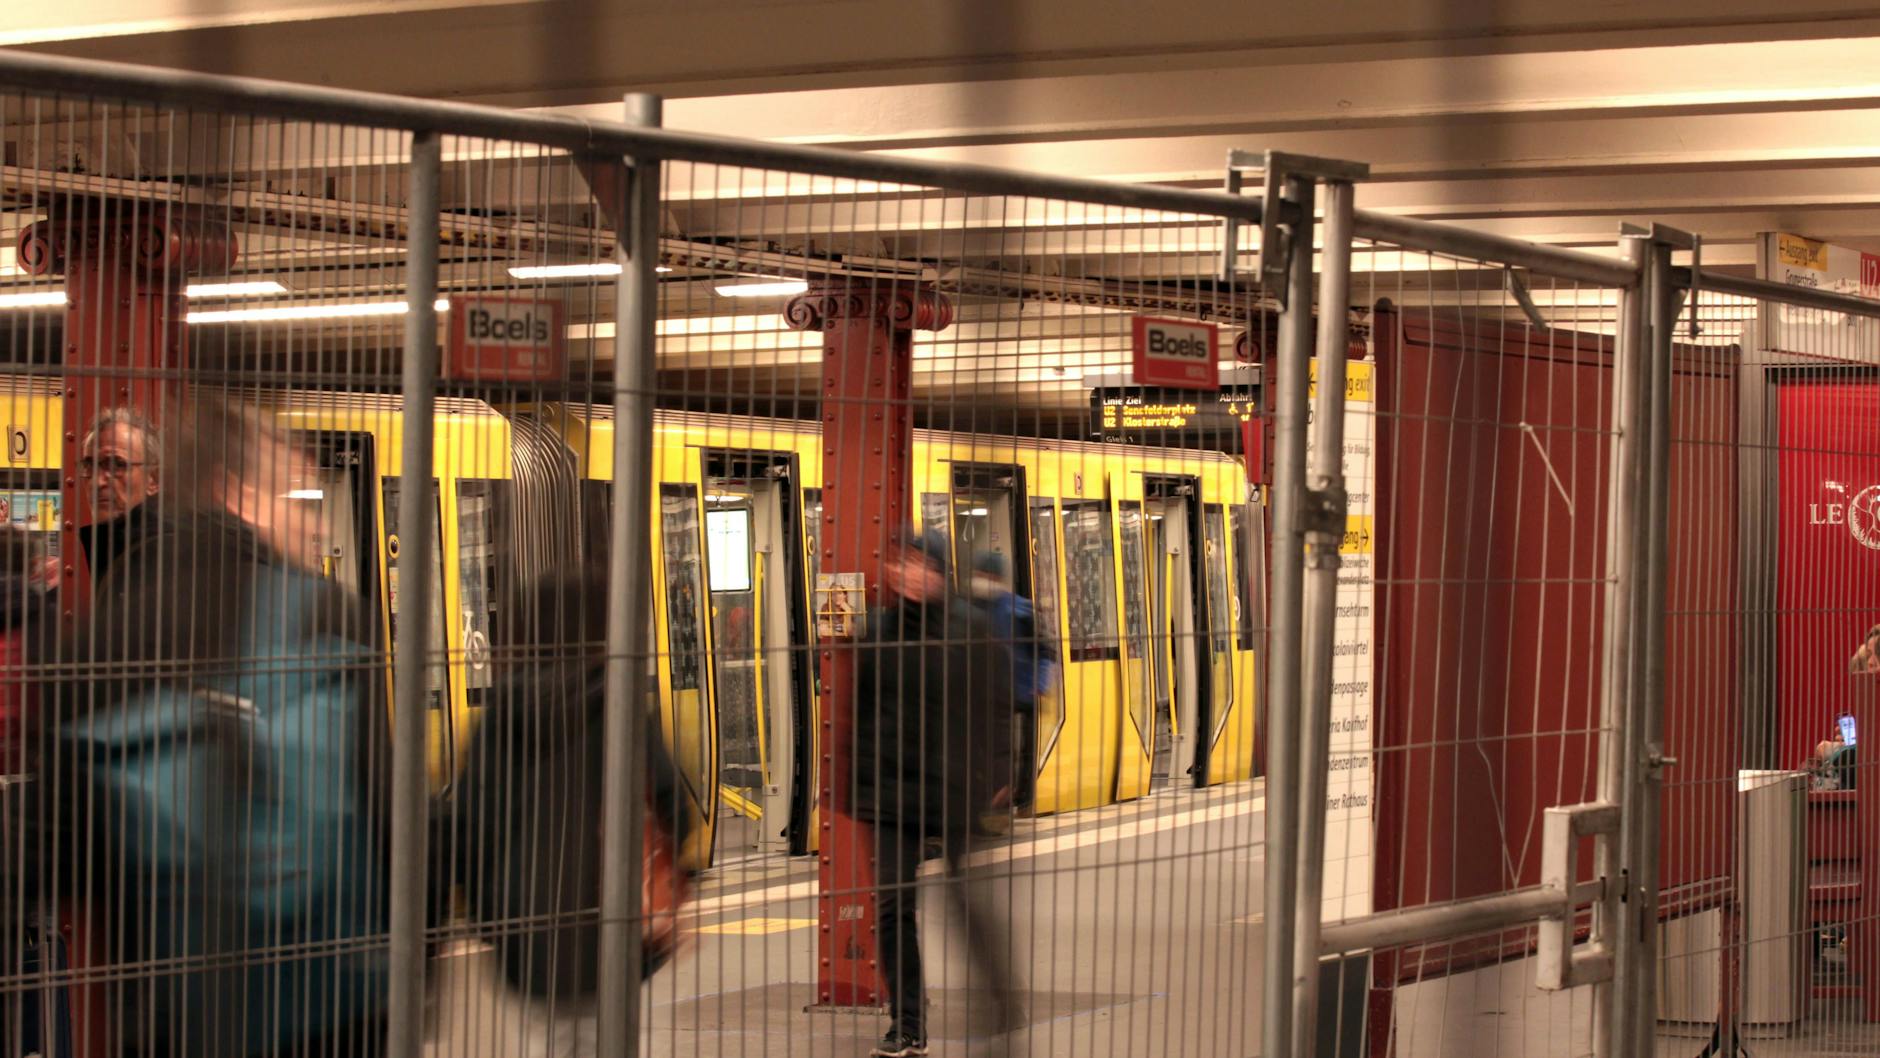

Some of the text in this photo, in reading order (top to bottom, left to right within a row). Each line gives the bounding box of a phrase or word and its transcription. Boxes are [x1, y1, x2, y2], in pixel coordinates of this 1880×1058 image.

[1861, 257, 1878, 295] U2
[469, 310, 547, 340] Boels
[1149, 329, 1206, 358] Boels
[1103, 396, 1123, 406] Linie
[1125, 396, 1142, 405] Ziel
[1104, 405, 1116, 416] U2
[1104, 416, 1116, 428] U2
[1347, 492, 1370, 507] gcenter
[1809, 503, 1844, 525] LE
[1336, 602, 1369, 617] rnsehturm
[1327, 792, 1368, 810] iner Rathaus
